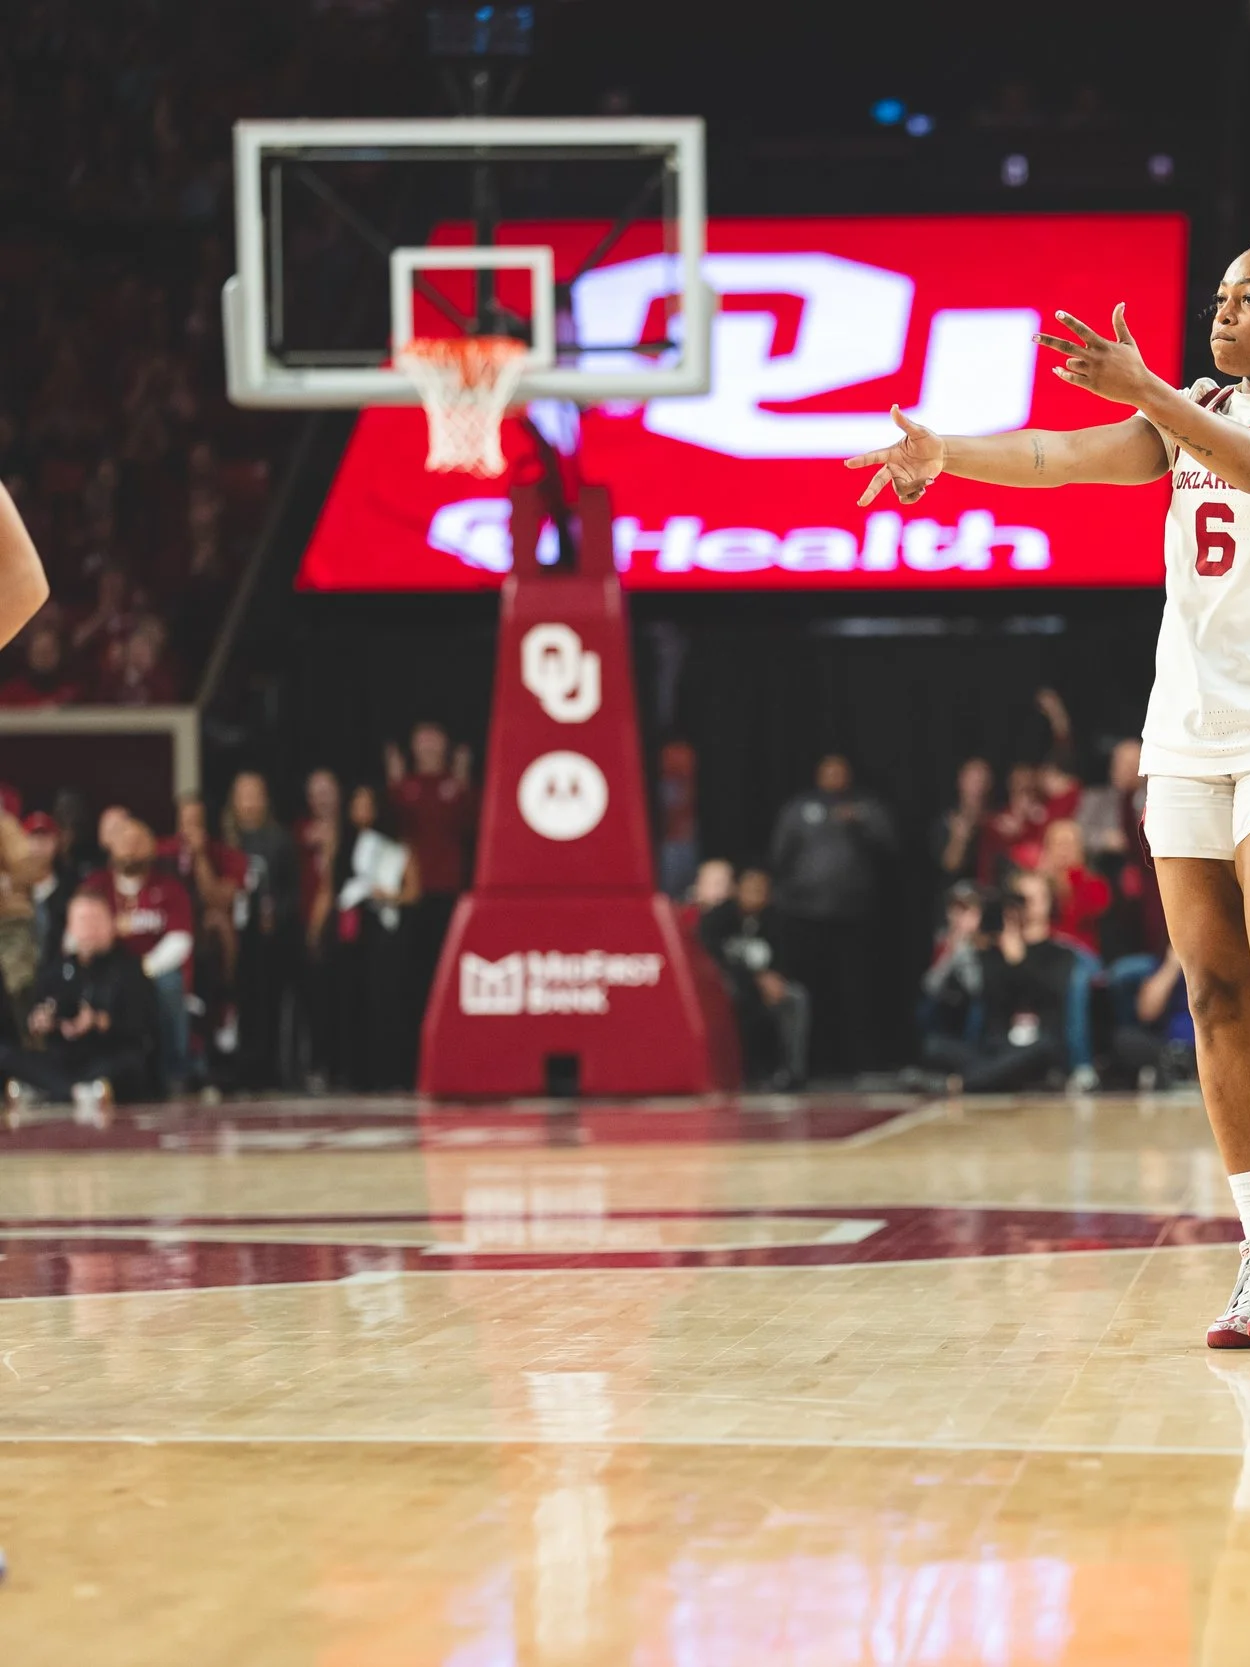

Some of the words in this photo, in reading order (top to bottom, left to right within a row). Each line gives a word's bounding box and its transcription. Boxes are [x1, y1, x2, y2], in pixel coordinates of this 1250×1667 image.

[570, 251, 1041, 459] OU
[1176, 470, 1237, 490] OKLAH
[611, 510, 1051, 573] Health
[1195, 501, 1236, 576] 6
[519, 622, 601, 724] OU
